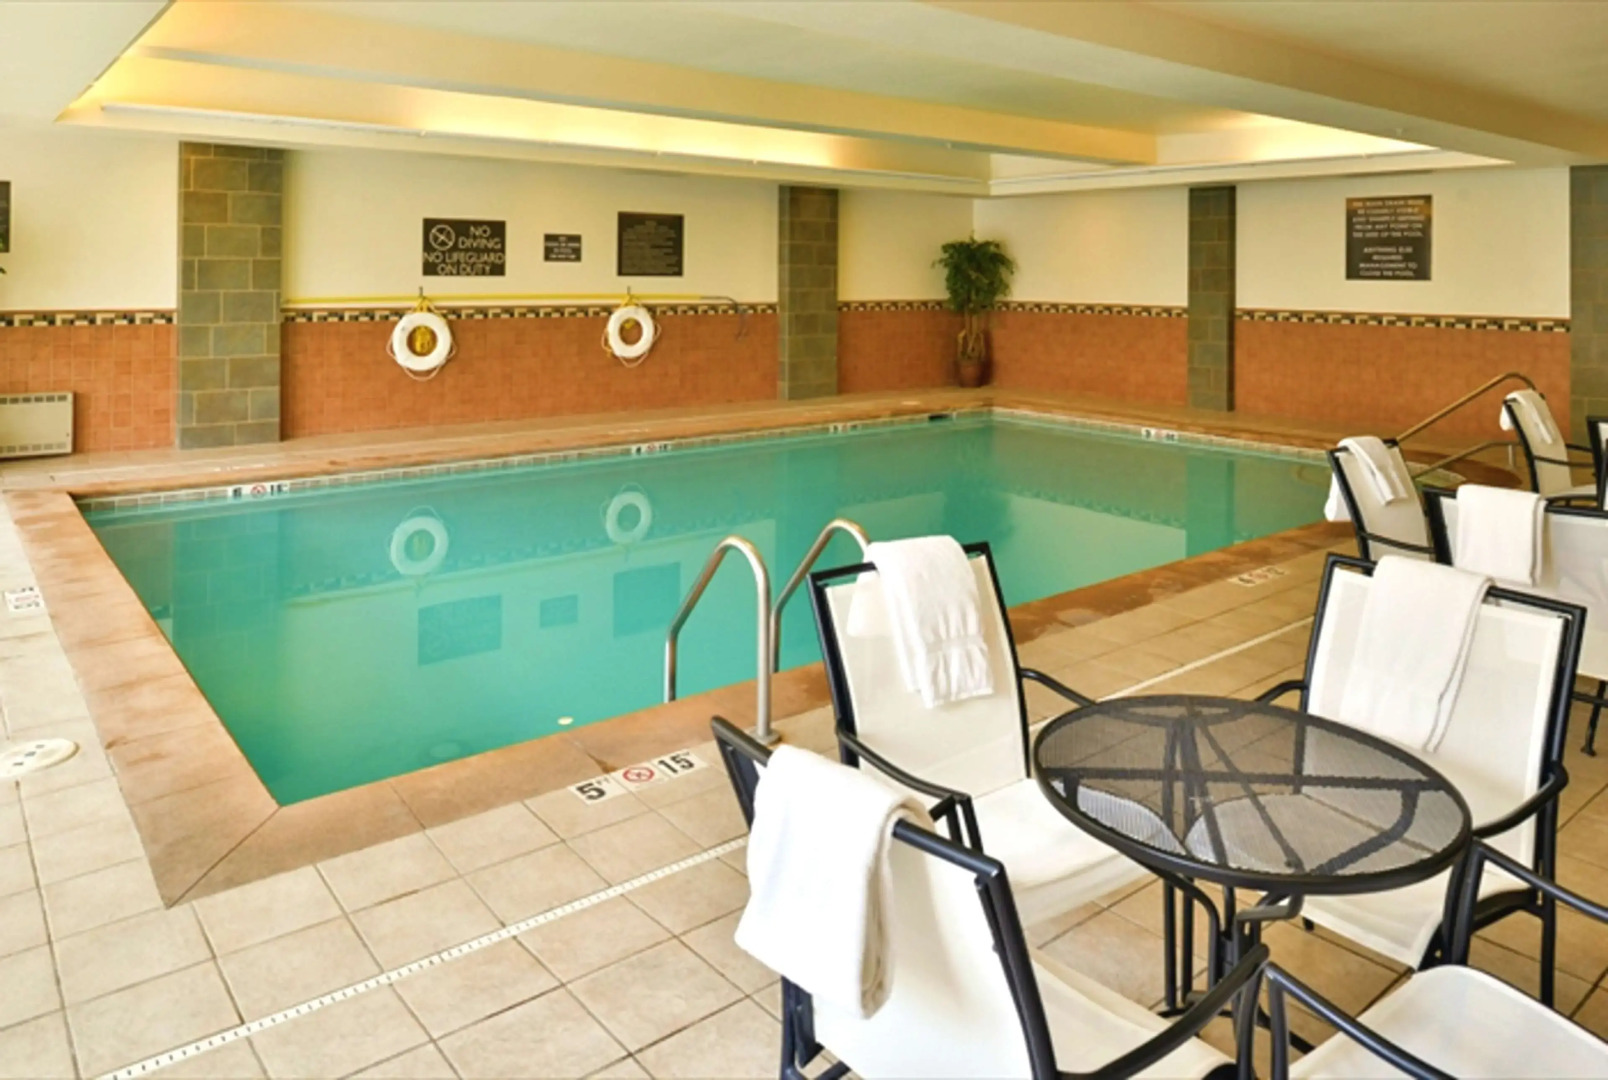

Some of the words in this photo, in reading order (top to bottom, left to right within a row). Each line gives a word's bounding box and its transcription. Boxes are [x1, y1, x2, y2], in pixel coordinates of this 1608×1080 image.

[470, 225, 491, 237] NO
[458, 236, 501, 249] DIVING
[423, 251, 443, 263] NO
[445, 251, 505, 264] LIFEGUARD
[437, 263, 457, 275] ON
[459, 263, 491, 275] DUTY
